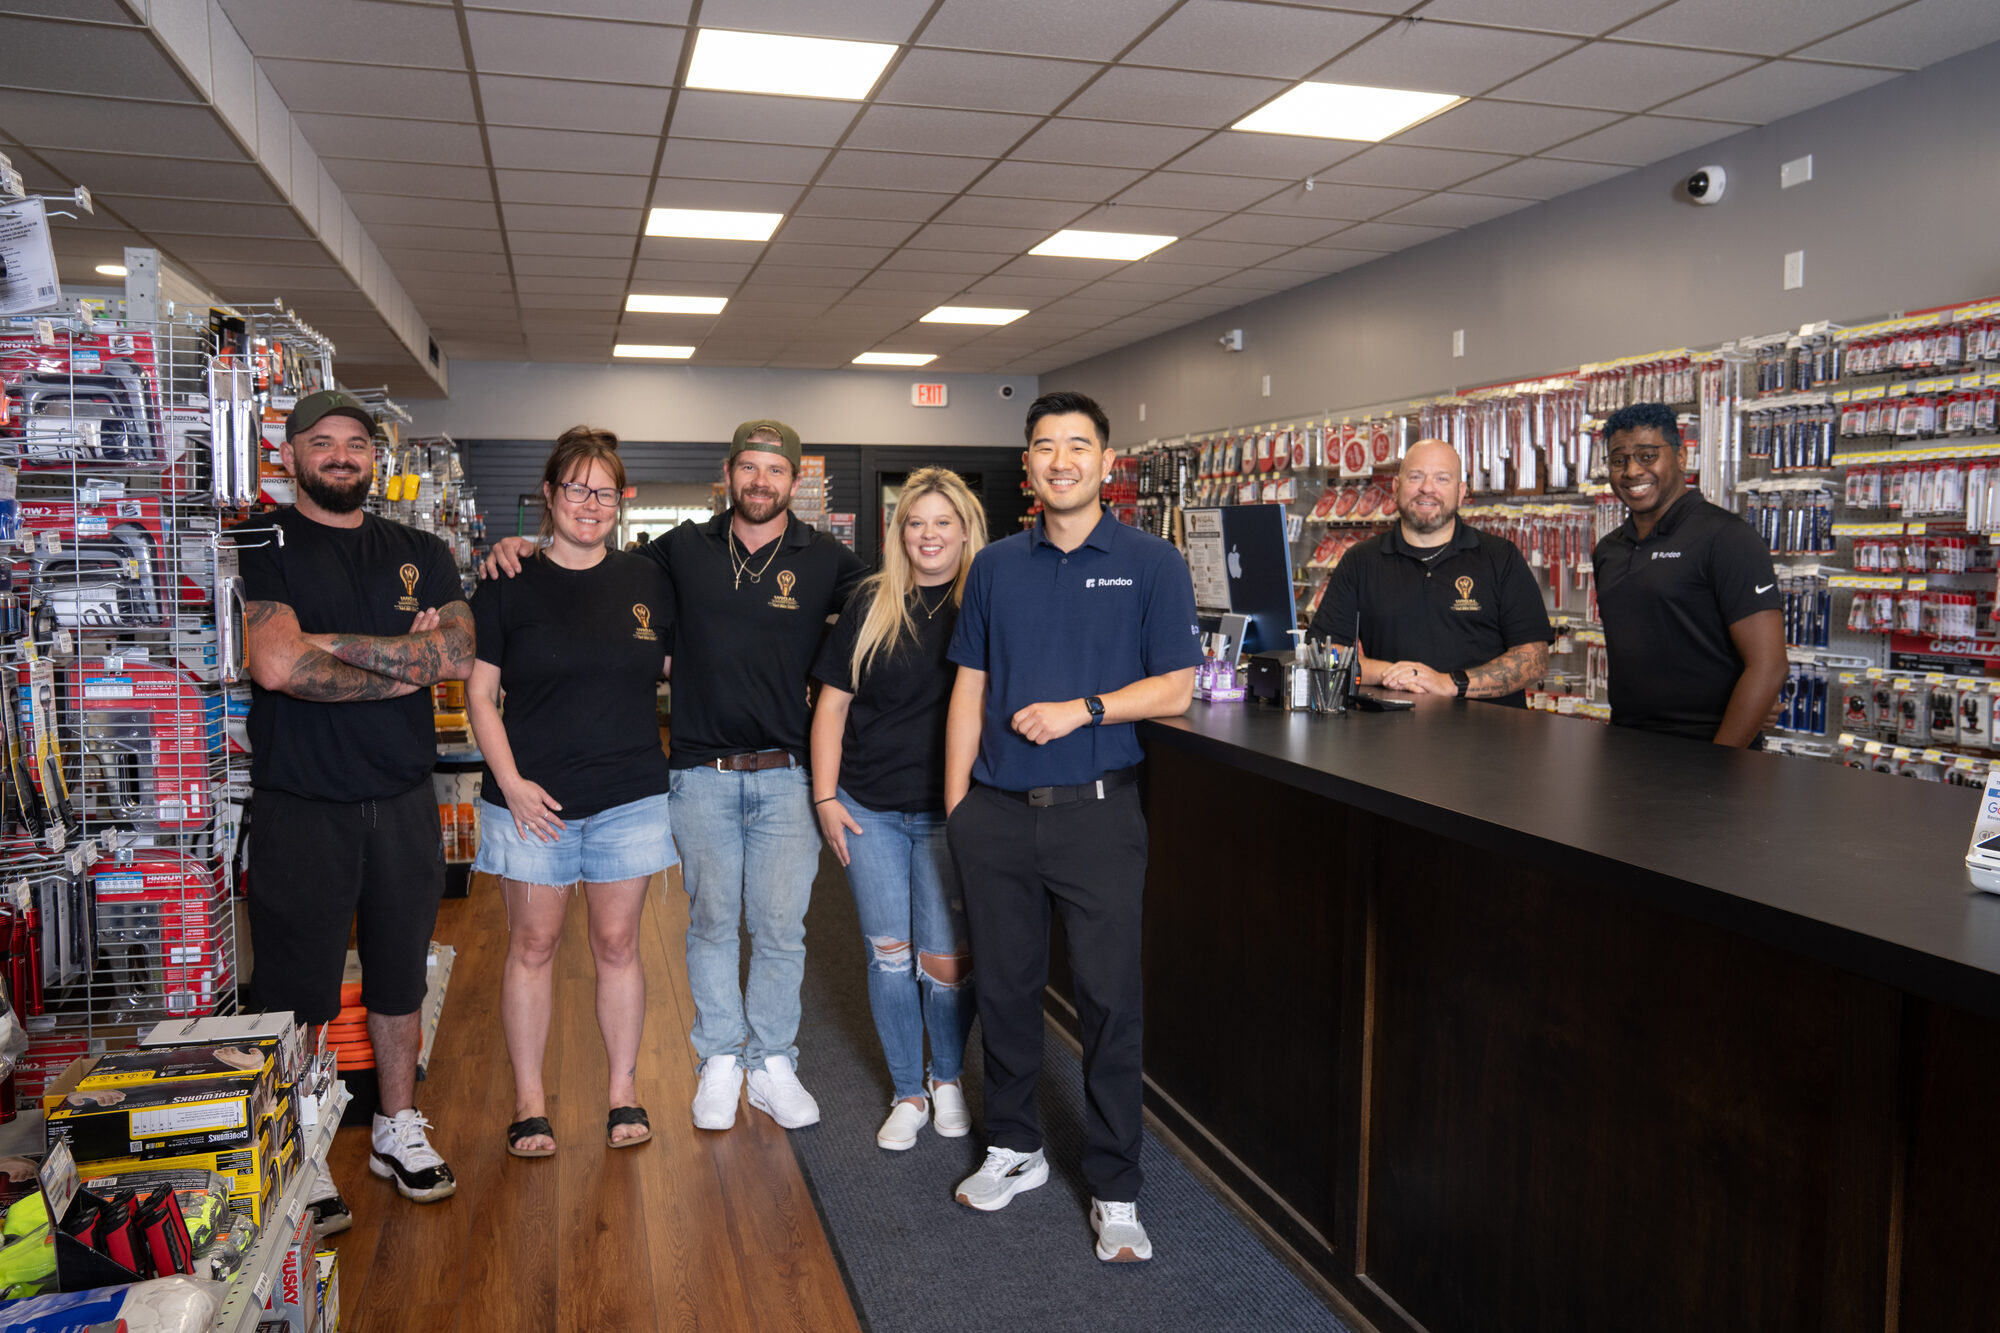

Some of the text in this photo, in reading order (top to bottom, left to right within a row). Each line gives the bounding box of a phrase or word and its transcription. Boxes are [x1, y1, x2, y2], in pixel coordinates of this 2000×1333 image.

[918, 384, 943, 404] EXIT
[1098, 577, 1133, 587] Rundoo
[282, 1250, 299, 1305] HUSKY
